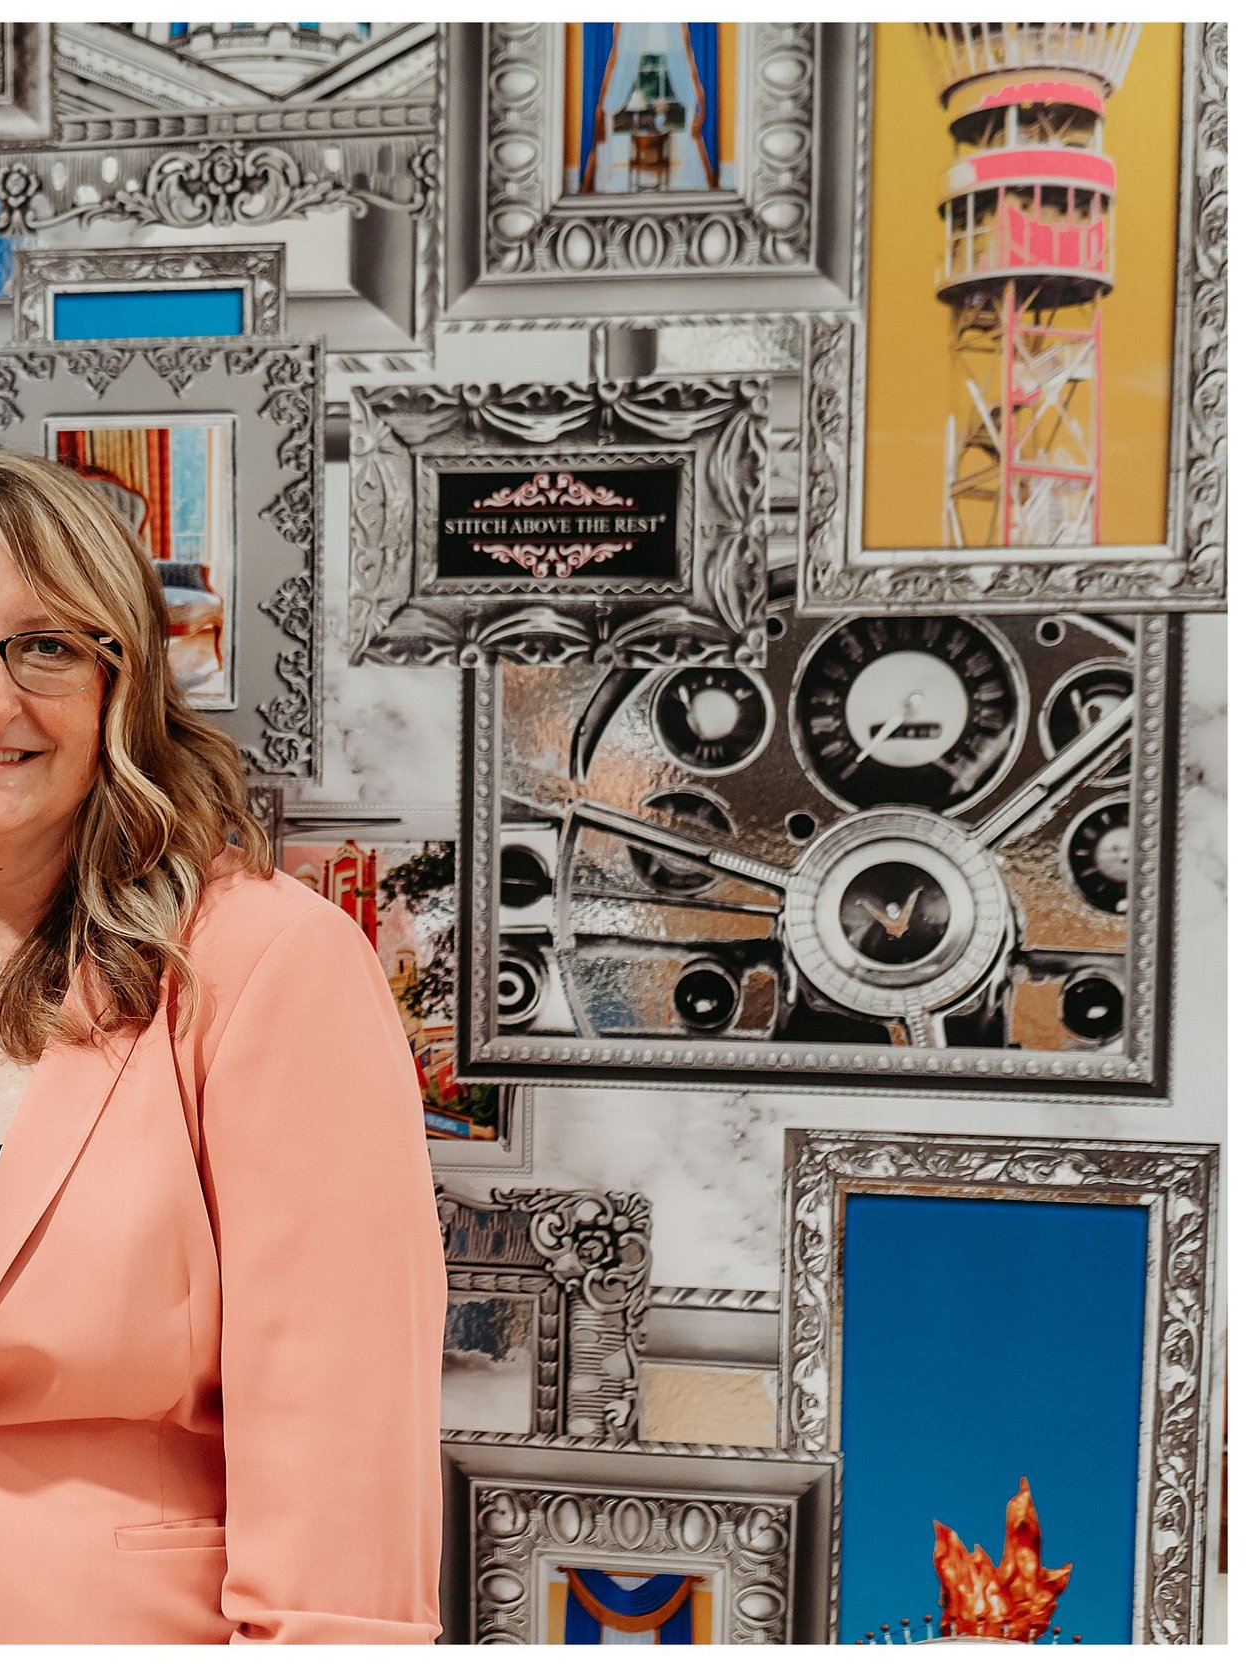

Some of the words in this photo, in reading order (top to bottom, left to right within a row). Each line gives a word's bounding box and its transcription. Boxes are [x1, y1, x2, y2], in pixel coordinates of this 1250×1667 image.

[445, 516, 507, 534] STITCH
[510, 516, 572, 534] ABOVE
[575, 515, 610, 533] THE
